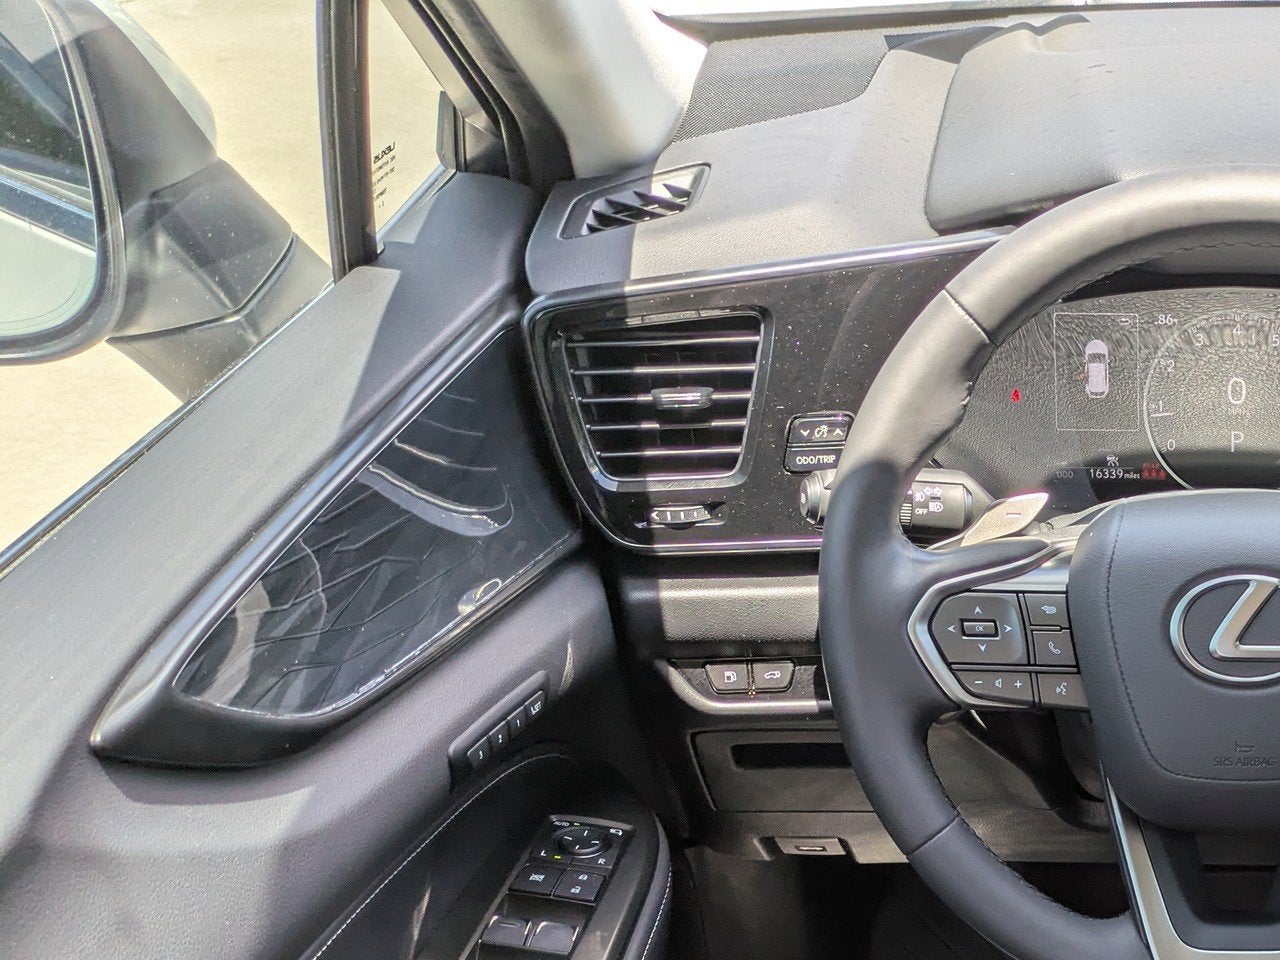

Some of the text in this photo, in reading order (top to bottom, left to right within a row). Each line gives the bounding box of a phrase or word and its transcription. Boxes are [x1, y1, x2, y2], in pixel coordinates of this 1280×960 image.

[1233, 324, 1241, 335] 4
[1196, 334, 1204, 346] 3
[1272, 335, 1280, 346] 5
[1166, 360, 1175, 372] 2
[1228, 377, 1246, 404] 0
[1168, 440, 1176, 450] 0
[1231, 431, 1245, 452] P
[796, 455, 836, 465] ODO/TRIP
[1090, 468, 1123, 479] 16339
[1213, 757, 1279, 768] SRS AIRBAG
[540, 849, 547, 857] L
[597, 857, 605, 866] R
